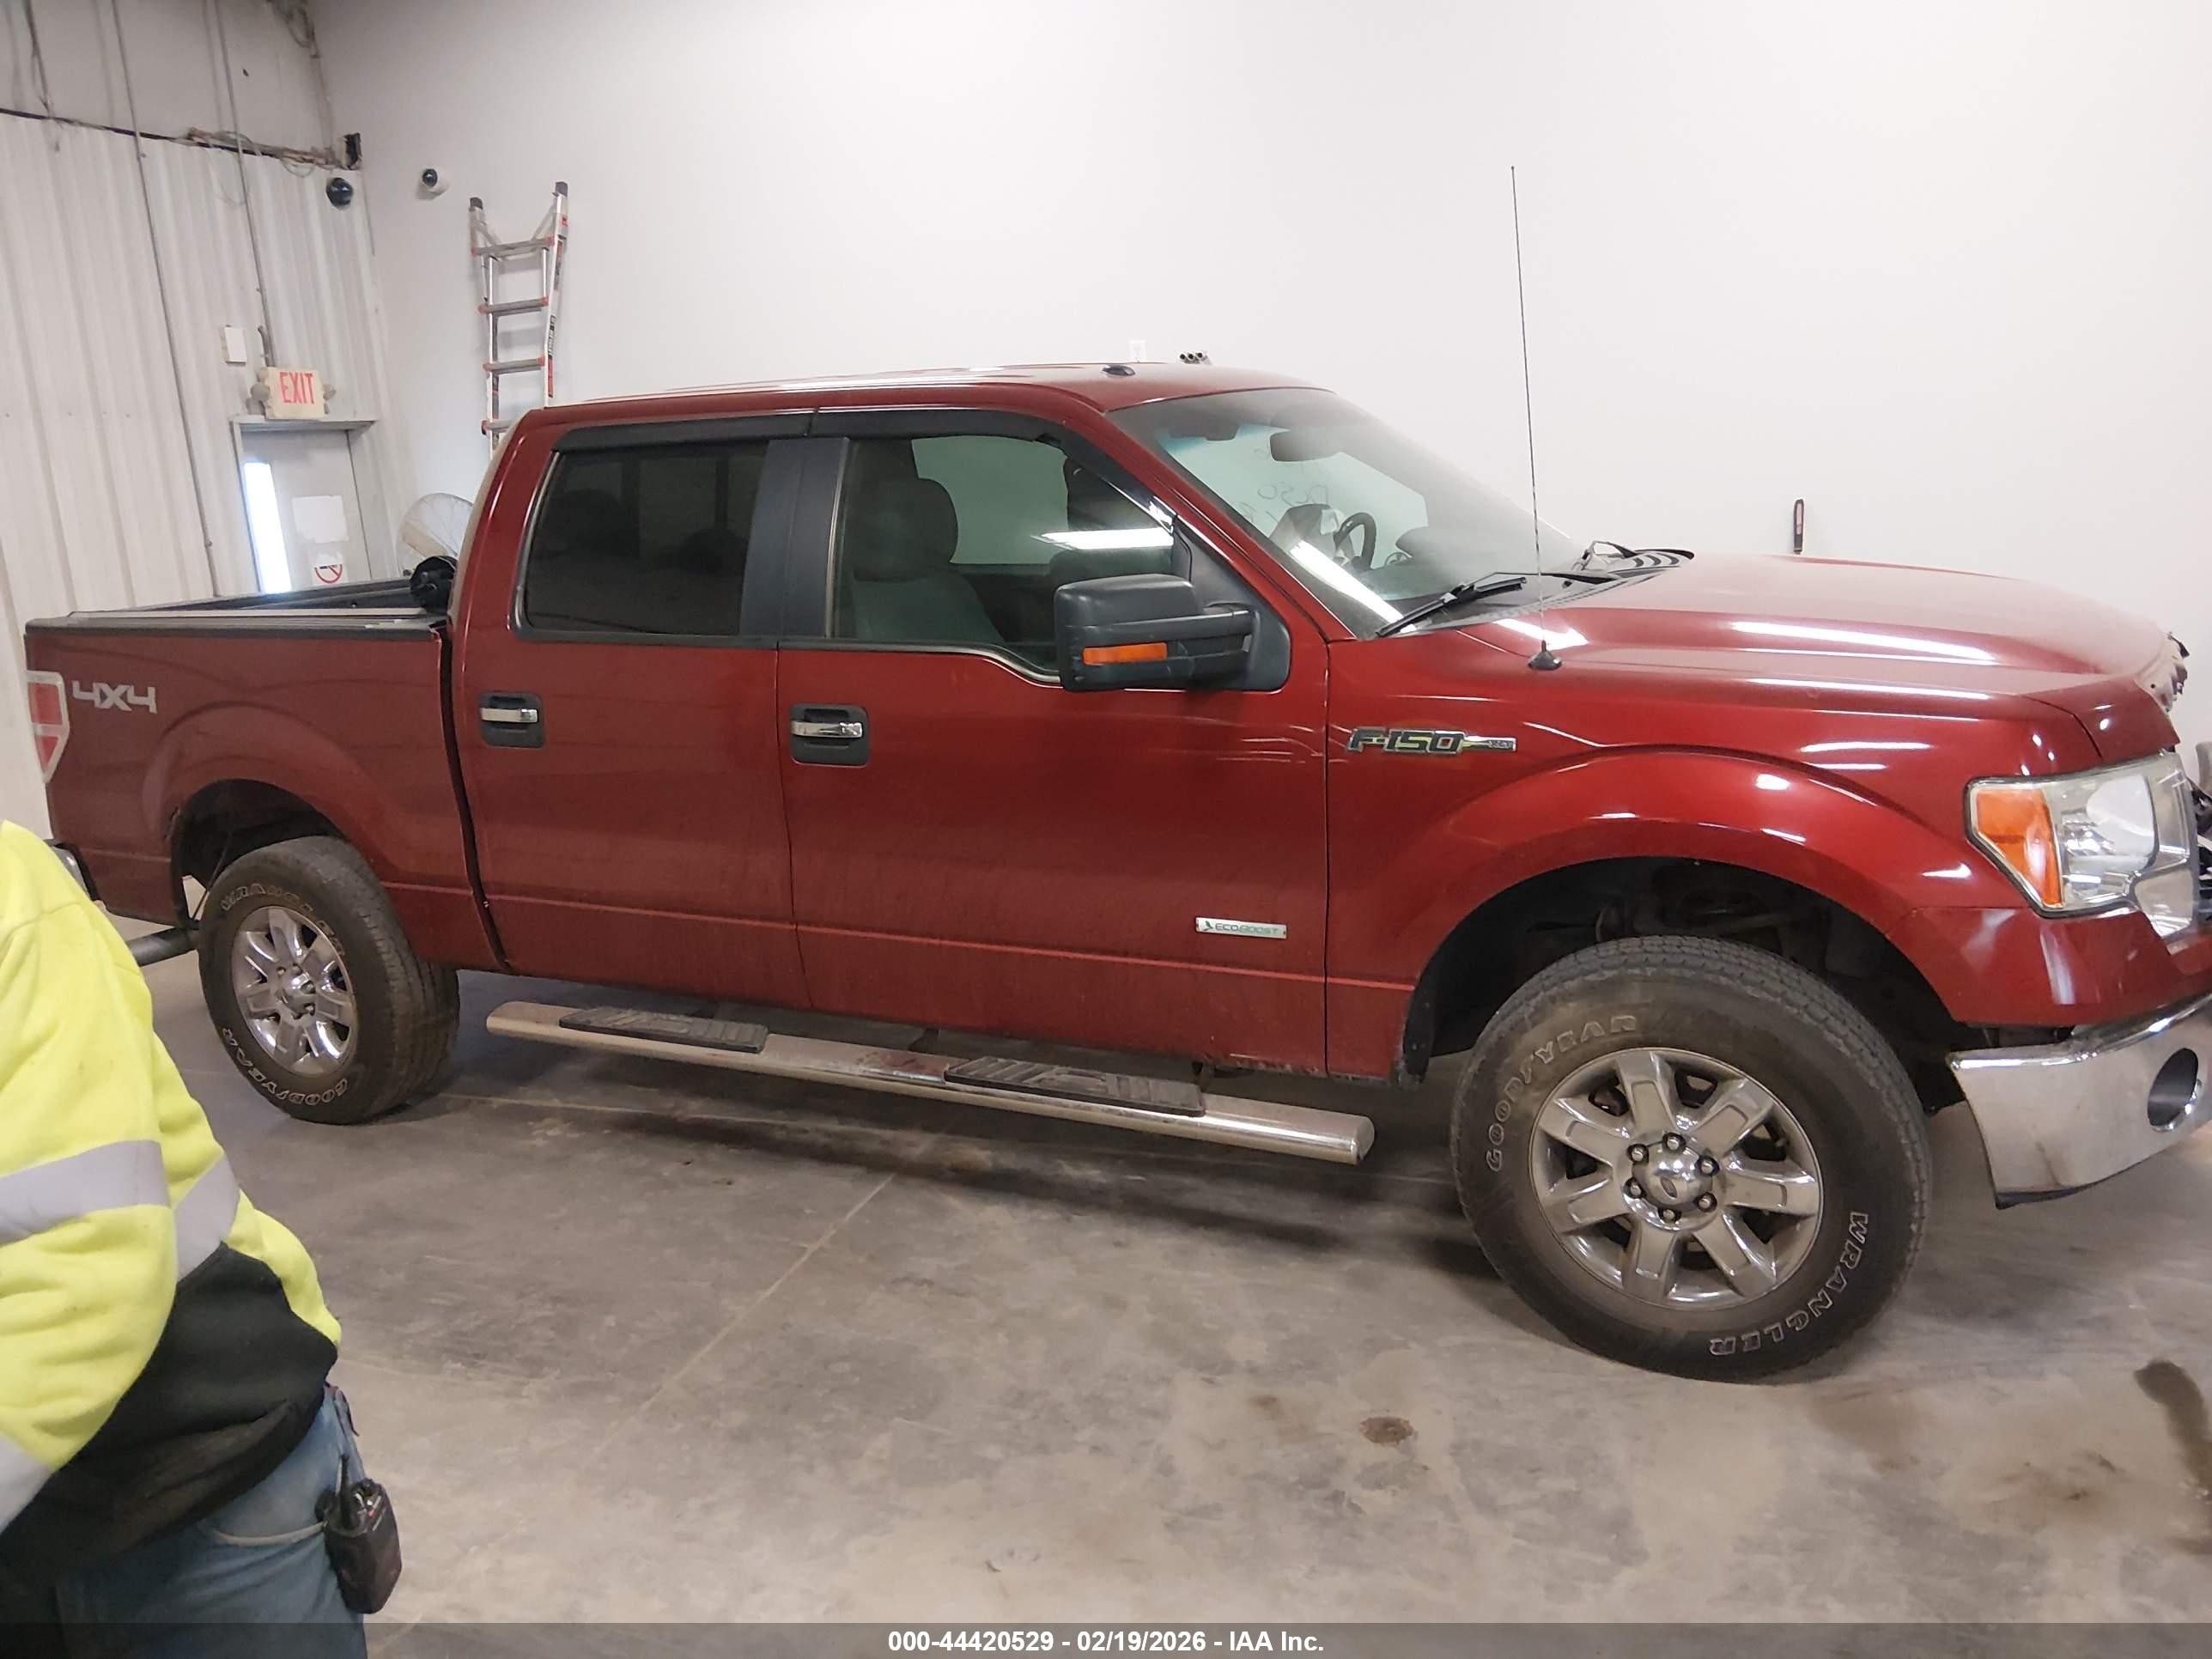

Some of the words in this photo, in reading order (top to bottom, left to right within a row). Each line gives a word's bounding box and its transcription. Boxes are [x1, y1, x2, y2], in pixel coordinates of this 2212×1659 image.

[279, 371, 315, 404] EXIT
[1347, 726, 1466, 754] F-150
[1215, 922, 1279, 934] ECOBOOST
[1486, 1014, 1637, 1172] GOODYEAR
[1709, 1211, 1869, 1356] WRANGLER
